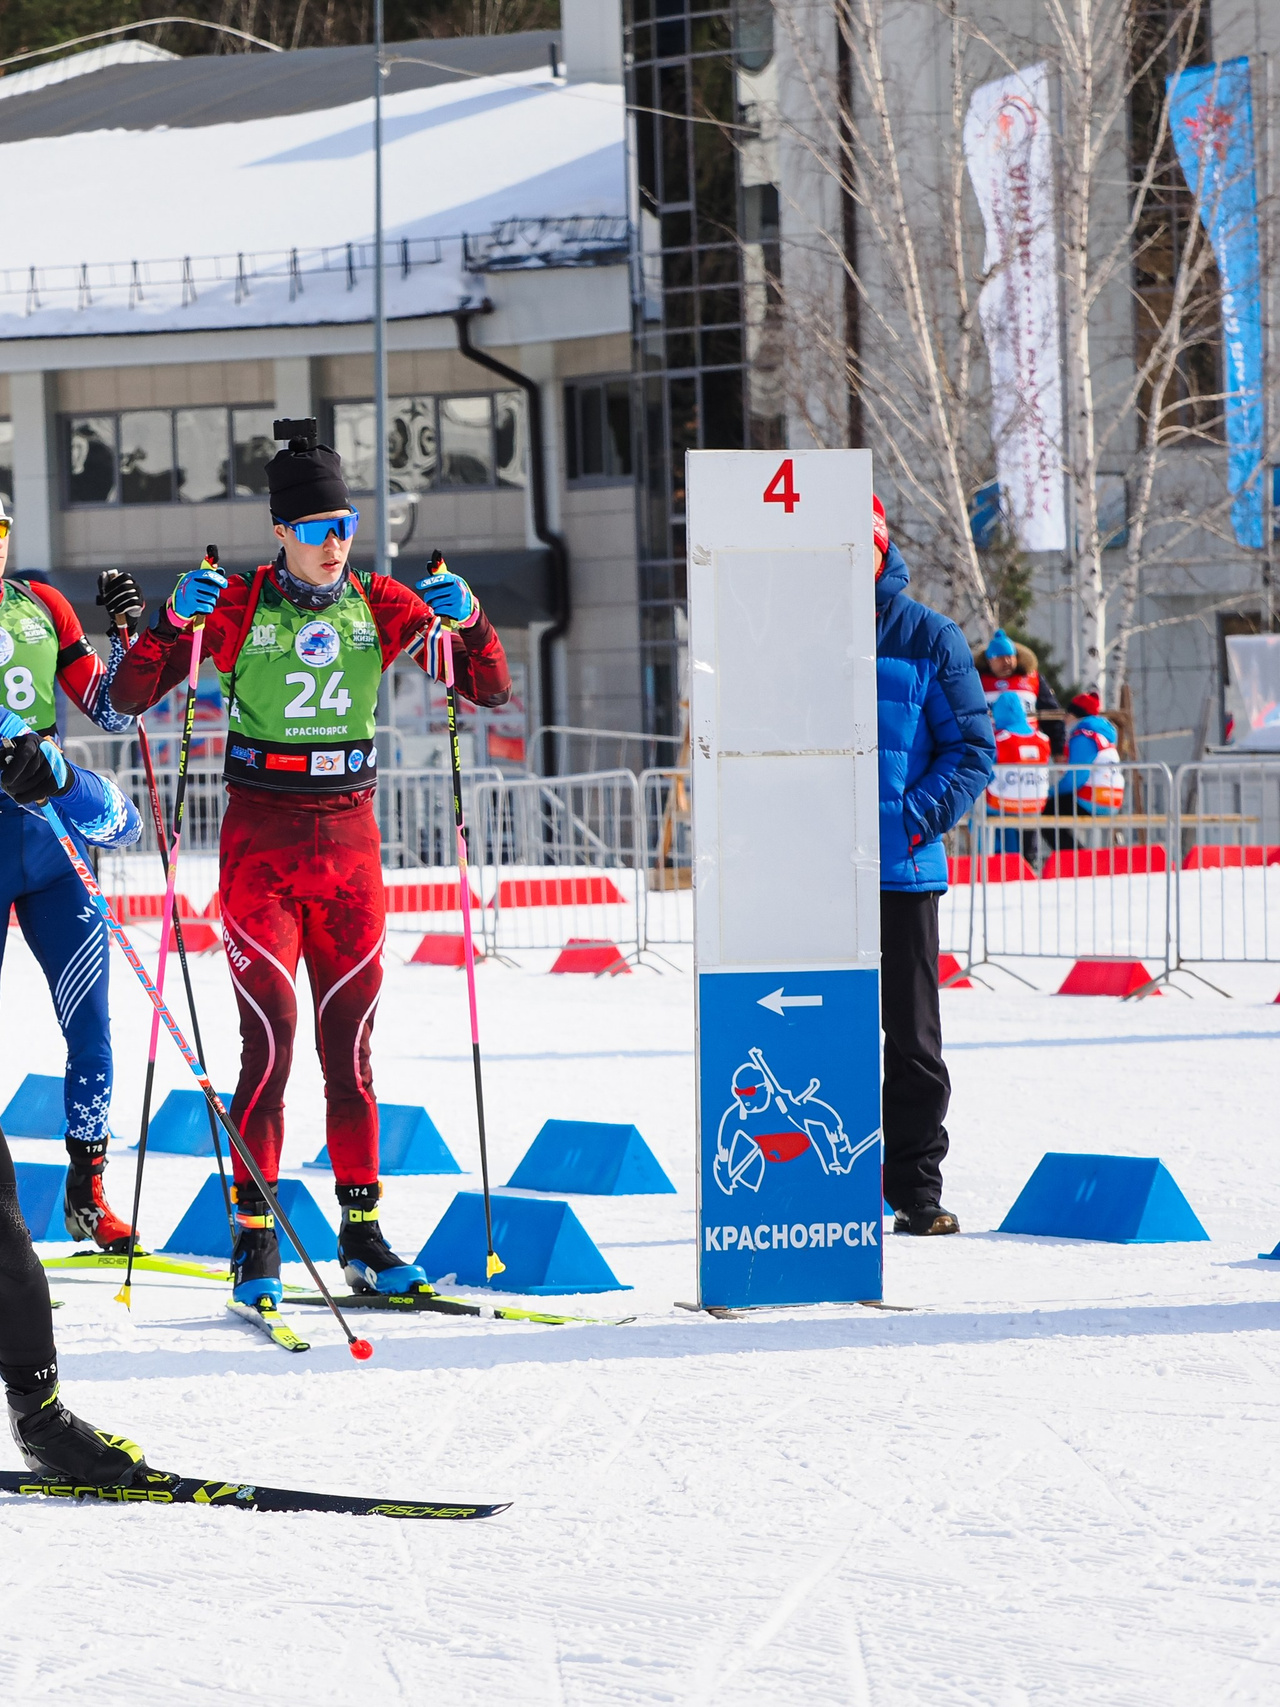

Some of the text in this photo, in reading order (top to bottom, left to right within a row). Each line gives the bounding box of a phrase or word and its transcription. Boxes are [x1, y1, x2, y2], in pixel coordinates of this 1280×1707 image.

[763, 459, 800, 513] 4
[284, 671, 352, 718] 24
[186, 697, 196, 734] LEKI
[285, 725, 348, 737] КРАСНОЯРСК
[86, 1144, 103, 1153] 178
[348, 1187, 368, 1197] 174
[705, 1221, 878, 1251] КРАСНОЯРСК
[97, 1257, 127, 1265] FISCHER
[370, 1504, 476, 1518] FISCHER
